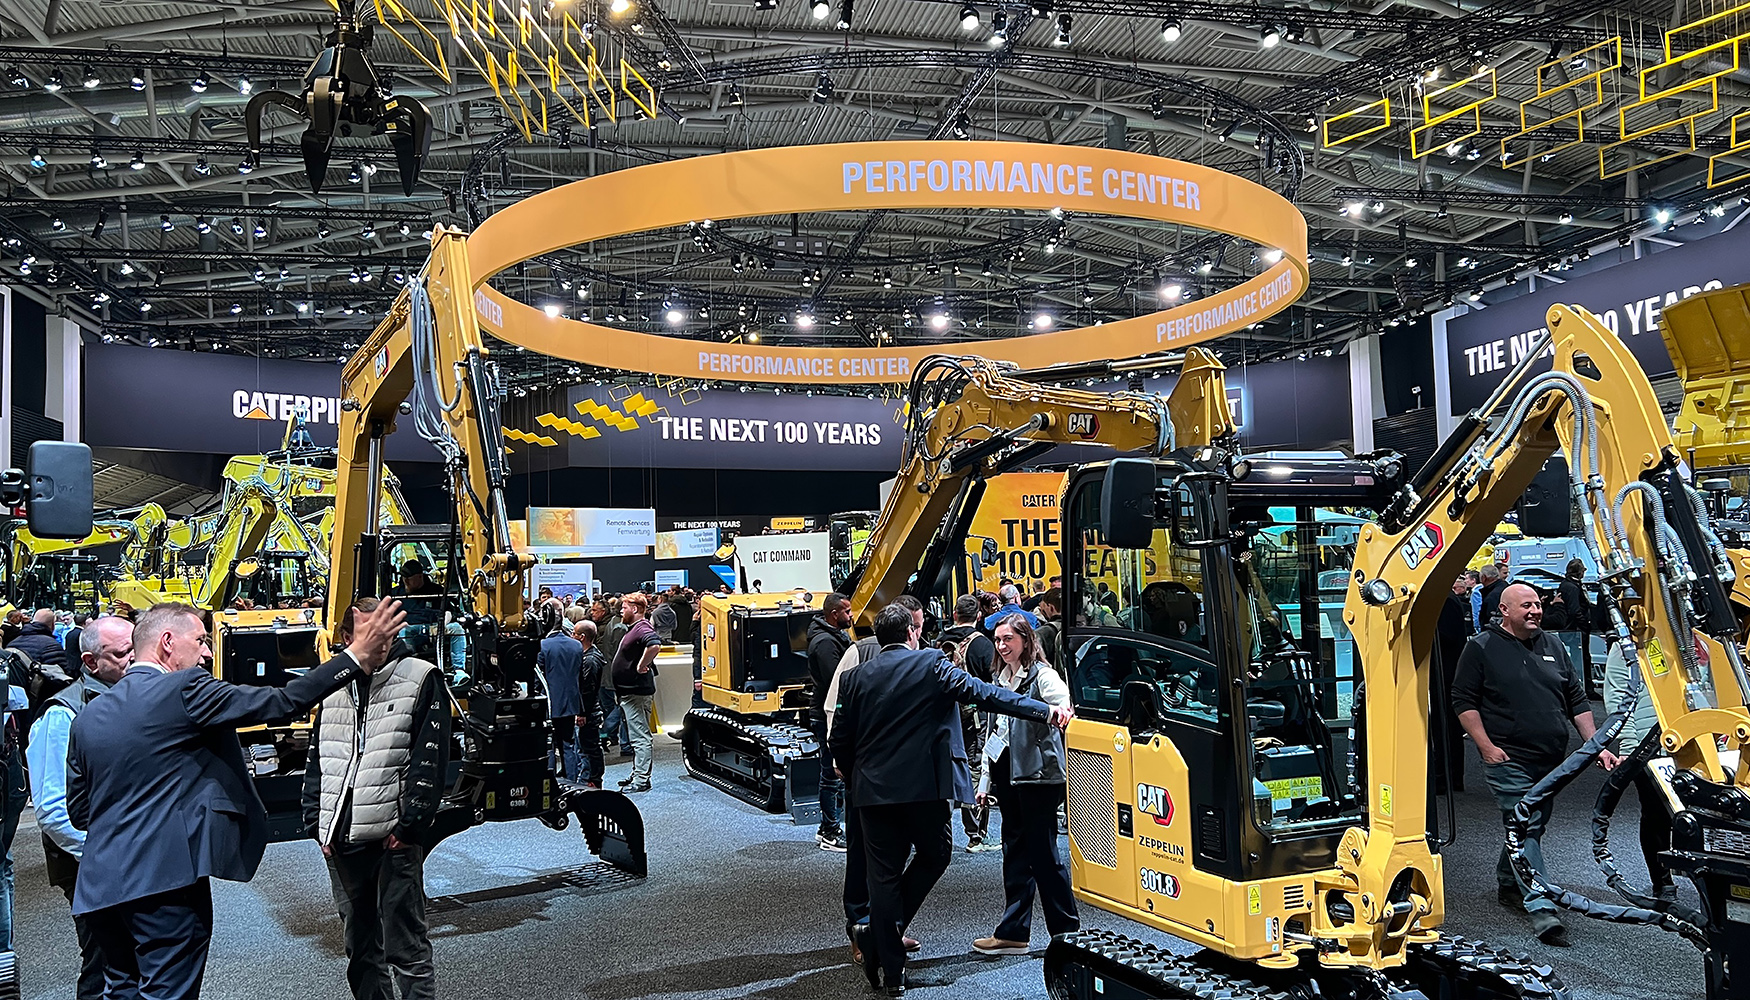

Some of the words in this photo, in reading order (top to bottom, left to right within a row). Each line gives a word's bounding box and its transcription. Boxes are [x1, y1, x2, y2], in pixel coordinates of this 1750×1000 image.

[843, 160, 1094, 196] PERFORMANCE
[1102, 168, 1201, 211] CENTER
[1156, 290, 1258, 343] PERFORMANCE
[1259, 268, 1292, 310] CENTER
[374, 346, 387, 379] CAT
[698, 352, 834, 376] PERFORMANCE
[838, 356, 910, 377] CENTER
[1464, 339, 1506, 376] THE
[232, 389, 341, 424] CATERPI
[658, 416, 704, 441] THE
[710, 417, 769, 443] NEXT
[774, 421, 808, 444] 100
[812, 421, 882, 446] YEARS
[1068, 412, 1093, 434] CAT
[306, 479, 321, 490] CAT
[1022, 494, 1058, 508] CATER
[617, 528, 651, 536] Fernwartung
[628, 519, 651, 527] Services
[673, 521, 687, 529] THE
[688, 521, 705, 529] NEXT
[706, 521, 718, 529] 100
[719, 520, 741, 528] YEARS
[1000, 518, 1059, 548] THE
[753, 551, 768, 563] CAT
[770, 549, 811, 562] COMMAND
[1401, 525, 1435, 569] CAT
[1495, 549, 1507, 560] CAT
[999, 549, 1046, 579] 100
[510, 786, 525, 797] CAT
[1136, 783, 1166, 818] CAT
[1138, 835, 1185, 857] ZEPPELIN
[1150, 851, 1186, 865] zeppelin-cat.de
[1141, 867, 1174, 897] 301.8
